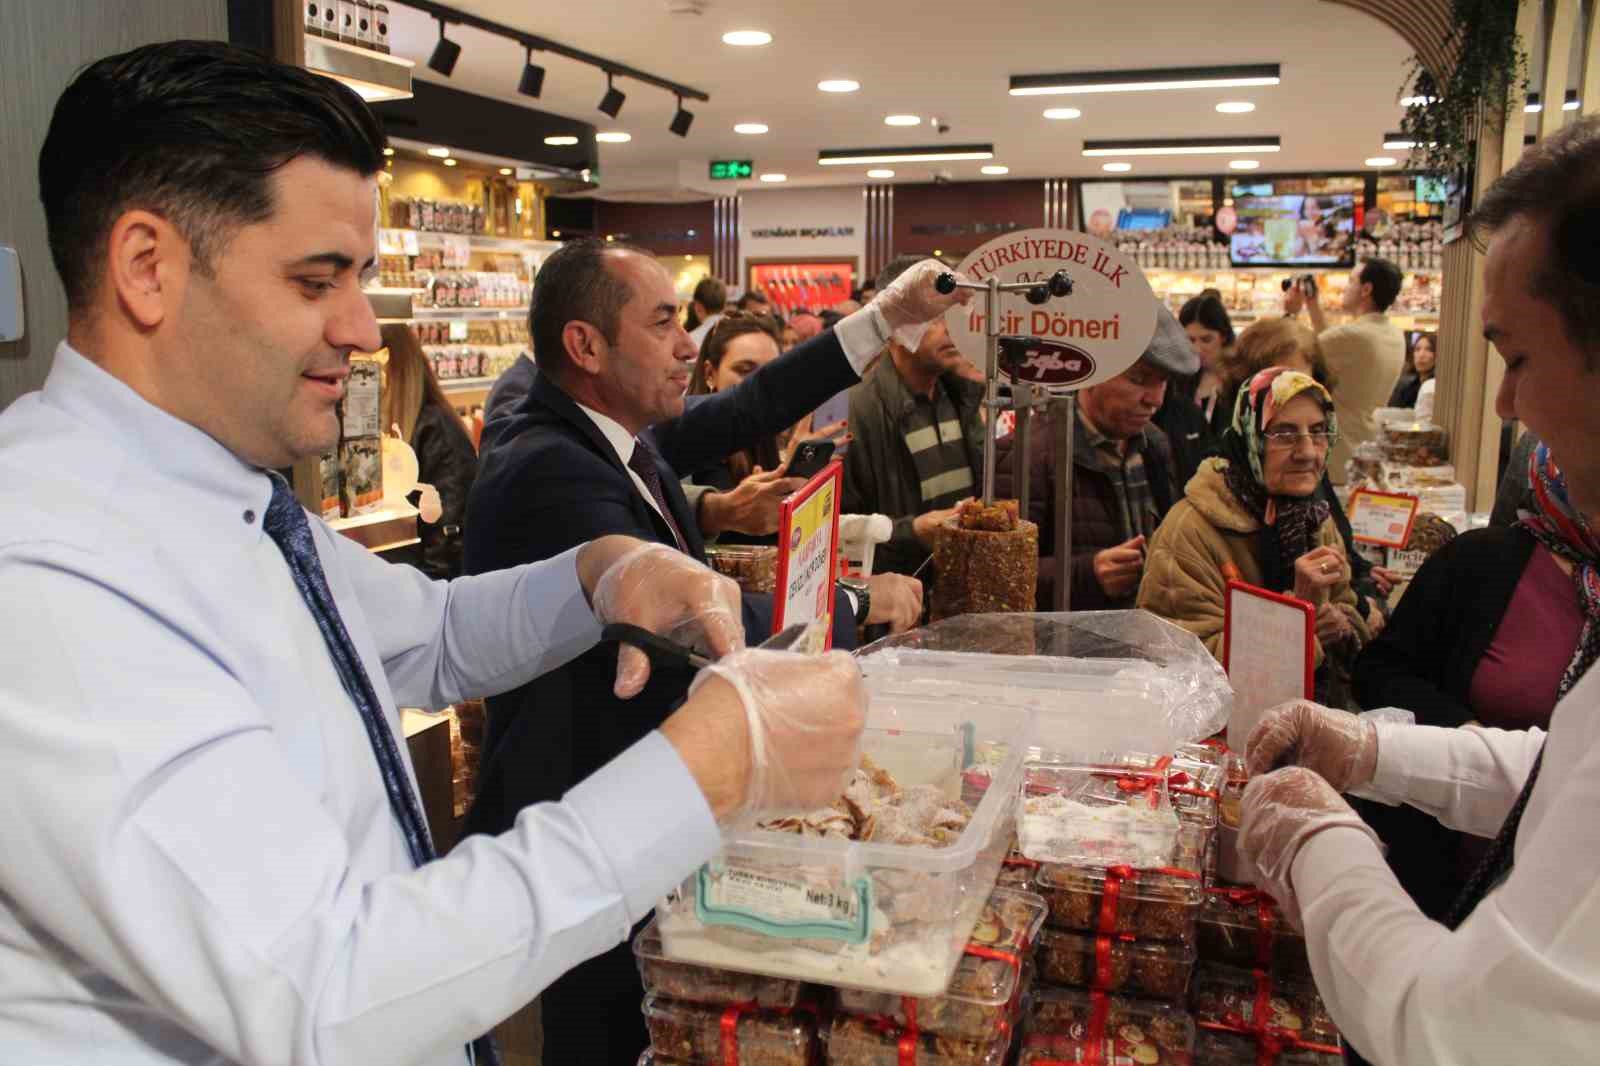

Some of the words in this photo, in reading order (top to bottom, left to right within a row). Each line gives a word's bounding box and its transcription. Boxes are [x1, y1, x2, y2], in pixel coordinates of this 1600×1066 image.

[967, 236, 1088, 281] TÜRKİYEDE
[1092, 247, 1128, 289] İLK
[1031, 311, 1120, 340] Döneri
